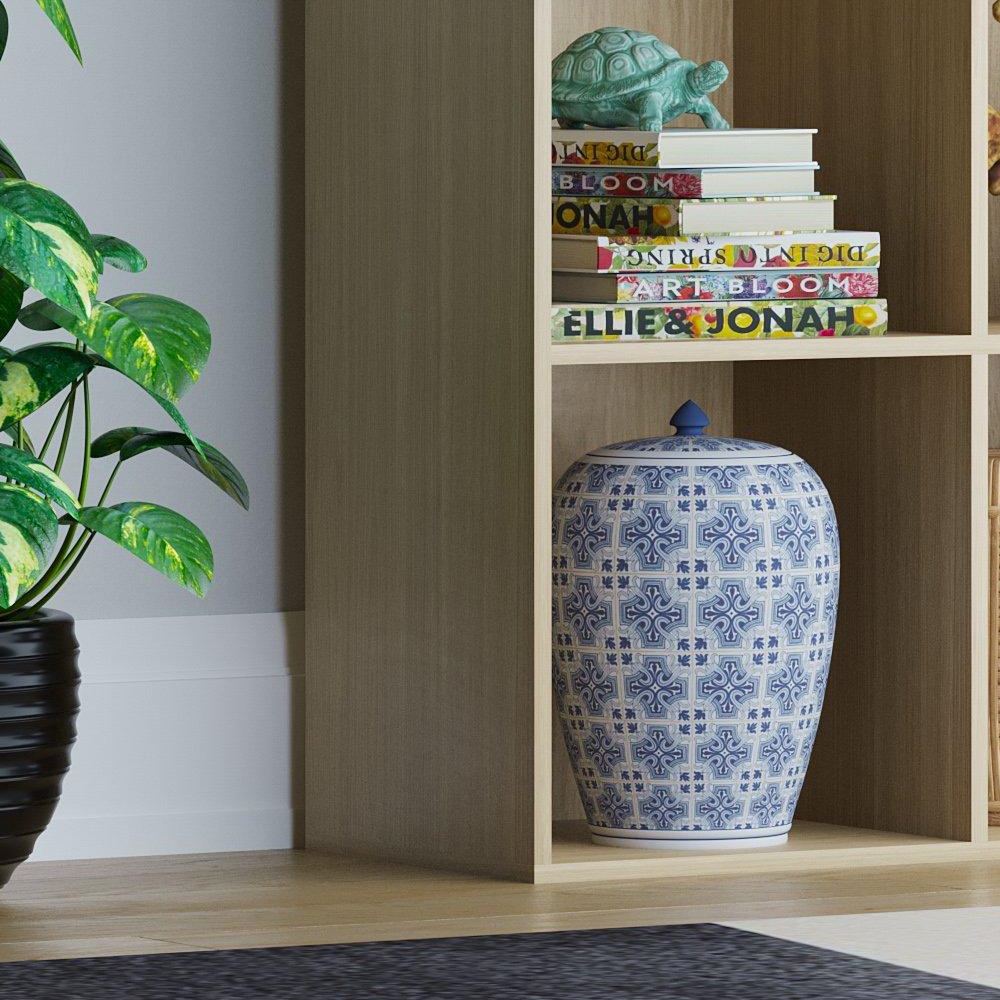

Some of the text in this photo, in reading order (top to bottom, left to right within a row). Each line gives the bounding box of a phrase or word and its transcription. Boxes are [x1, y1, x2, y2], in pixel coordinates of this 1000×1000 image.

[606, 144, 646, 161] DIG
[559, 174, 676, 191] BLOOM
[552, 201, 655, 230] ONAH
[628, 245, 864, 266] DIG INTO SPRING
[633, 276, 851, 297] ART BLOOM
[563, 309, 656, 336] ELLIE
[707, 307, 855, 334] JONAH
